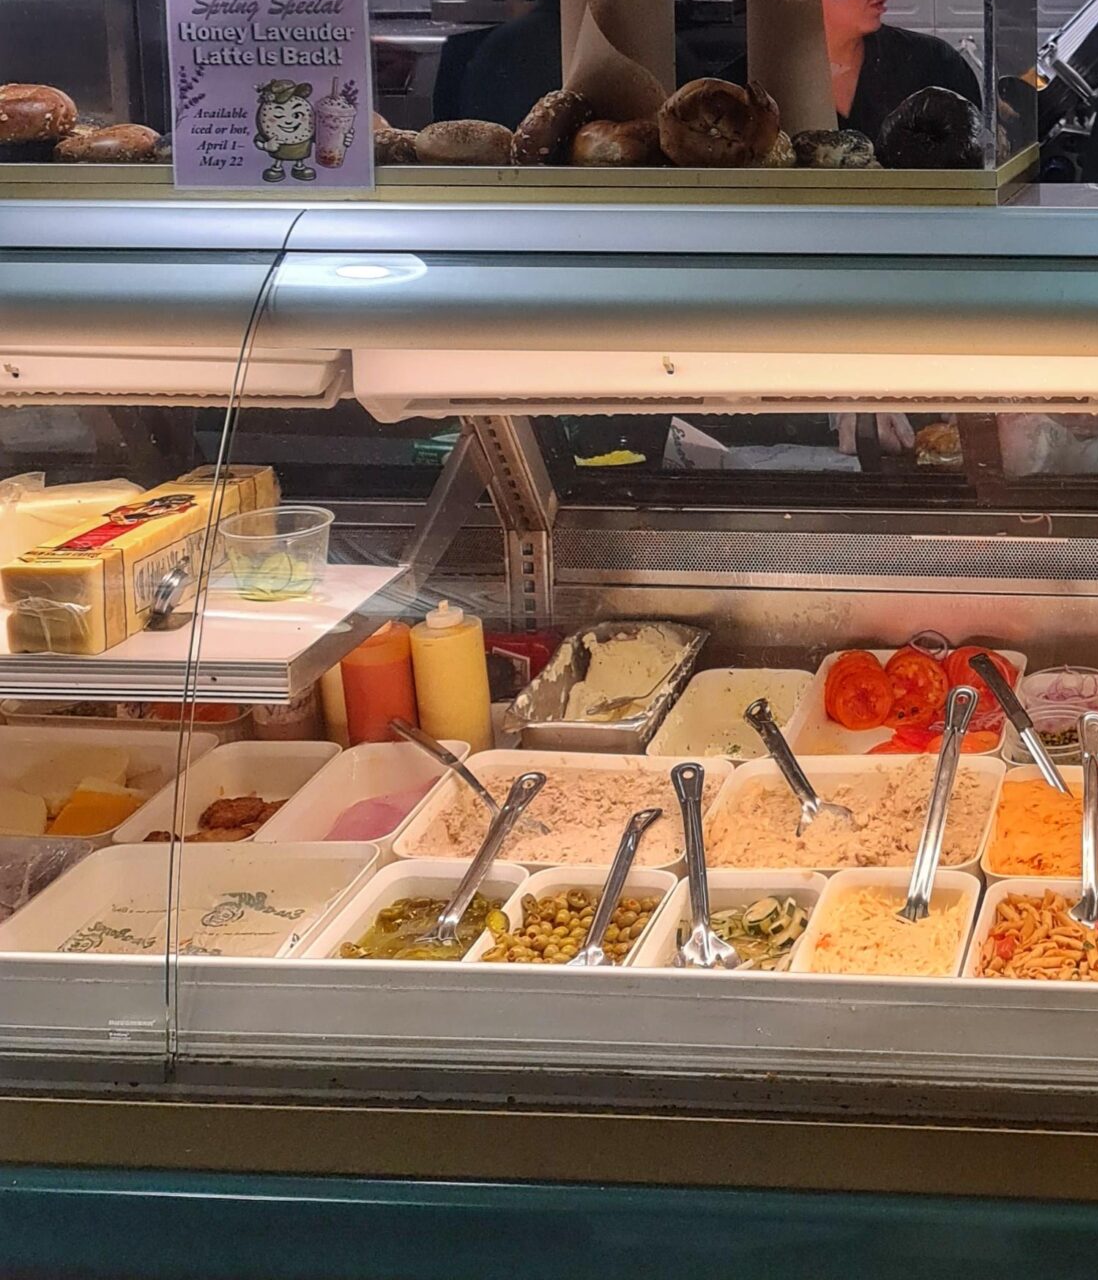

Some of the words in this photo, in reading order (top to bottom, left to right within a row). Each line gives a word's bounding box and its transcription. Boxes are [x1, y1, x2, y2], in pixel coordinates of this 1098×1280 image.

[179, 22, 247, 45] Honey
[252, 23, 355, 42] Lavender
[194, 46, 253, 65] Latte
[258, 47, 278, 65] Is
[282, 47, 343, 65] Back!
[194, 108, 248, 118] Available
[191, 124, 213, 134] iced
[230, 124, 250, 135] hot,
[197, 140, 228, 154] April
[199, 156, 226, 169] May
[229, 157, 243, 166] 22
